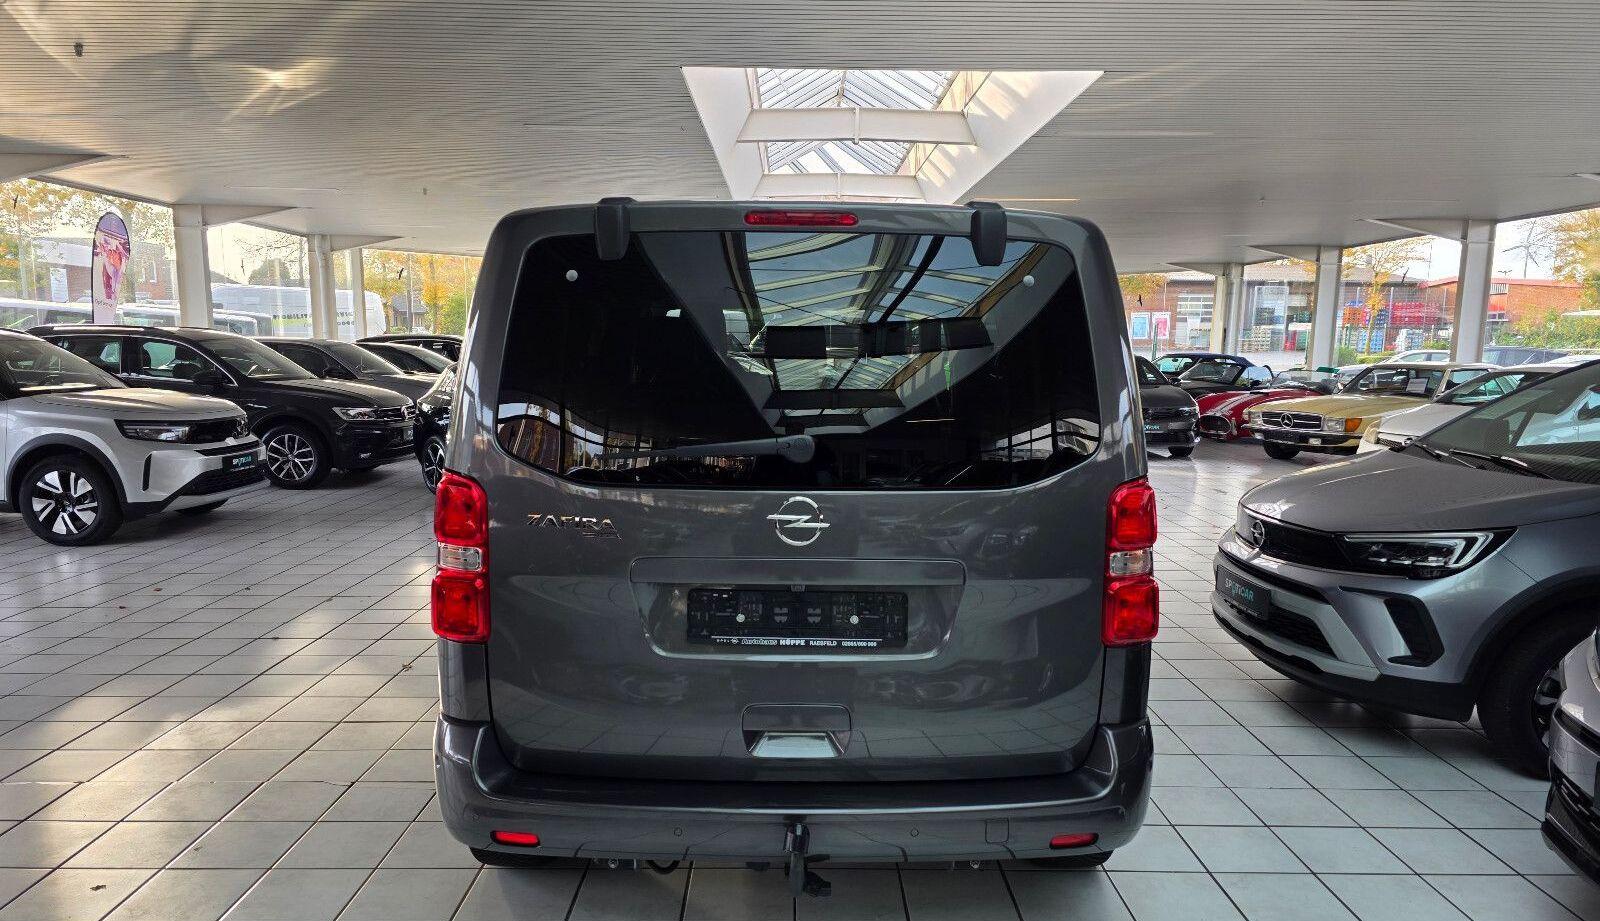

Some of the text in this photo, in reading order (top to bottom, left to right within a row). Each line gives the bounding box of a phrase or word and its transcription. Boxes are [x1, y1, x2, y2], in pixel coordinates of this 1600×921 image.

[526, 512, 617, 530] ZAFIRA
[1225, 578, 1254, 602] SPOTICAR
[741, 638, 778, 646] Autohaus
[779, 638, 806, 646] HÖPPE
